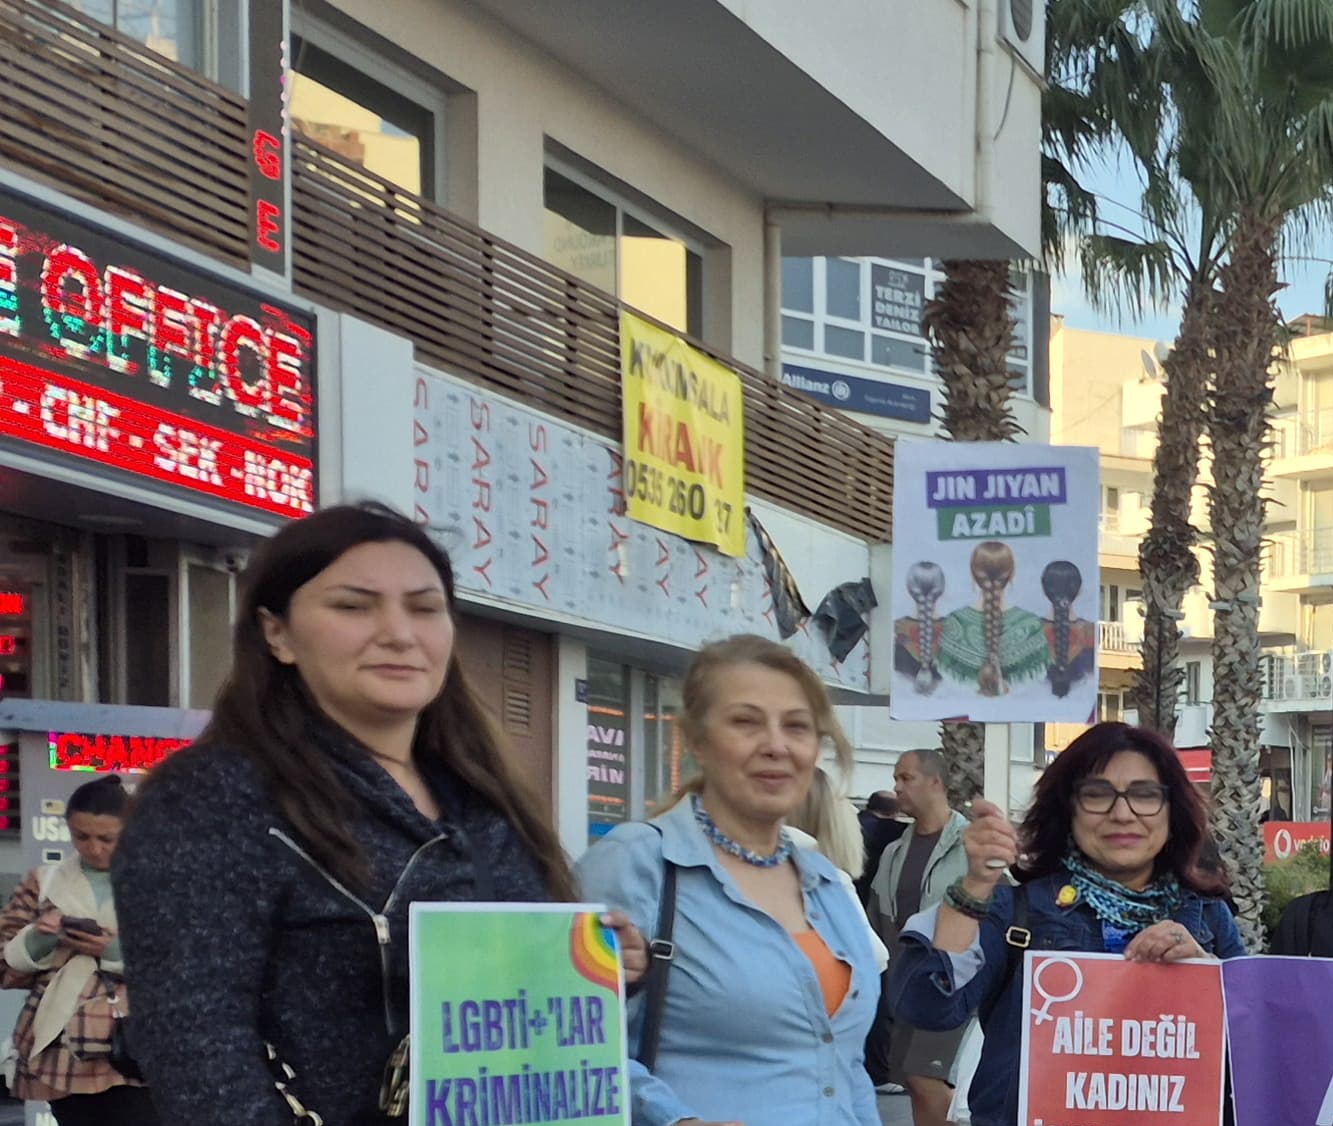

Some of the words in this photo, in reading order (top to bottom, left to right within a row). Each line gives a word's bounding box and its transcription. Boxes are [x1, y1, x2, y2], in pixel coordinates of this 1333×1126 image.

[874, 283, 922, 305] TERZİ
[783, 371, 831, 396] Allianz
[413, 376, 430, 530] SARA
[469, 396, 493, 588] SARAY
[932, 475, 976, 501] JIN
[983, 472, 1061, 500] JIYAN
[528, 421, 550, 601] SARAY
[951, 505, 1036, 537] AZADÎ
[441, 987, 607, 1054] LGBTİ+'LAR
[1052, 1009, 1115, 1056] AİLE
[1121, 1013, 1201, 1060] DEĞİL
[1065, 1071, 1186, 1113] KADINIZ
